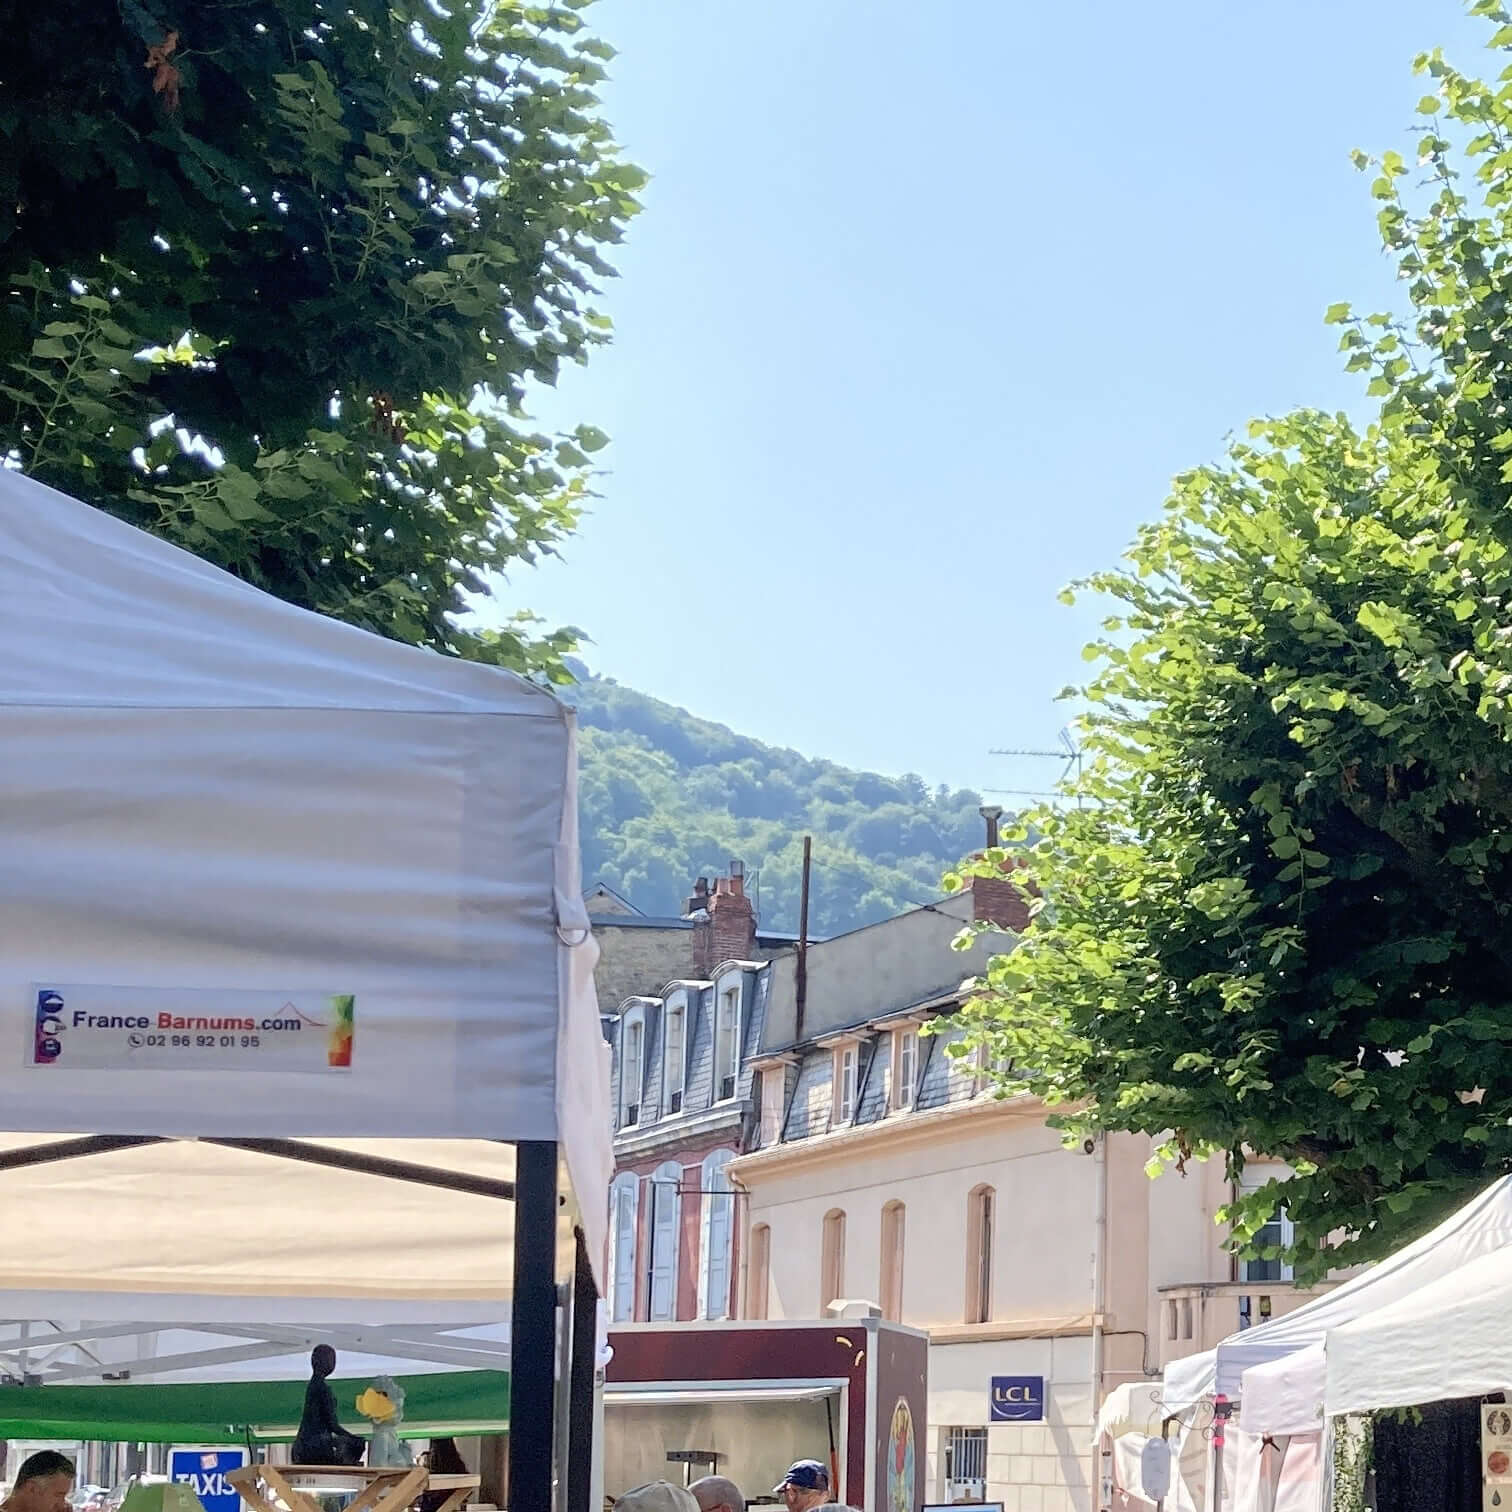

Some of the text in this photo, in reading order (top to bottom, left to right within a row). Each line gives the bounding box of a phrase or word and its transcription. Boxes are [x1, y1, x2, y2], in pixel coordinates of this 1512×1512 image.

[146, 1035, 165, 1047] 02
[196, 1036, 214, 1047] 92
[220, 1036, 234, 1047] 01
[995, 1386, 1038, 1402] LCL
